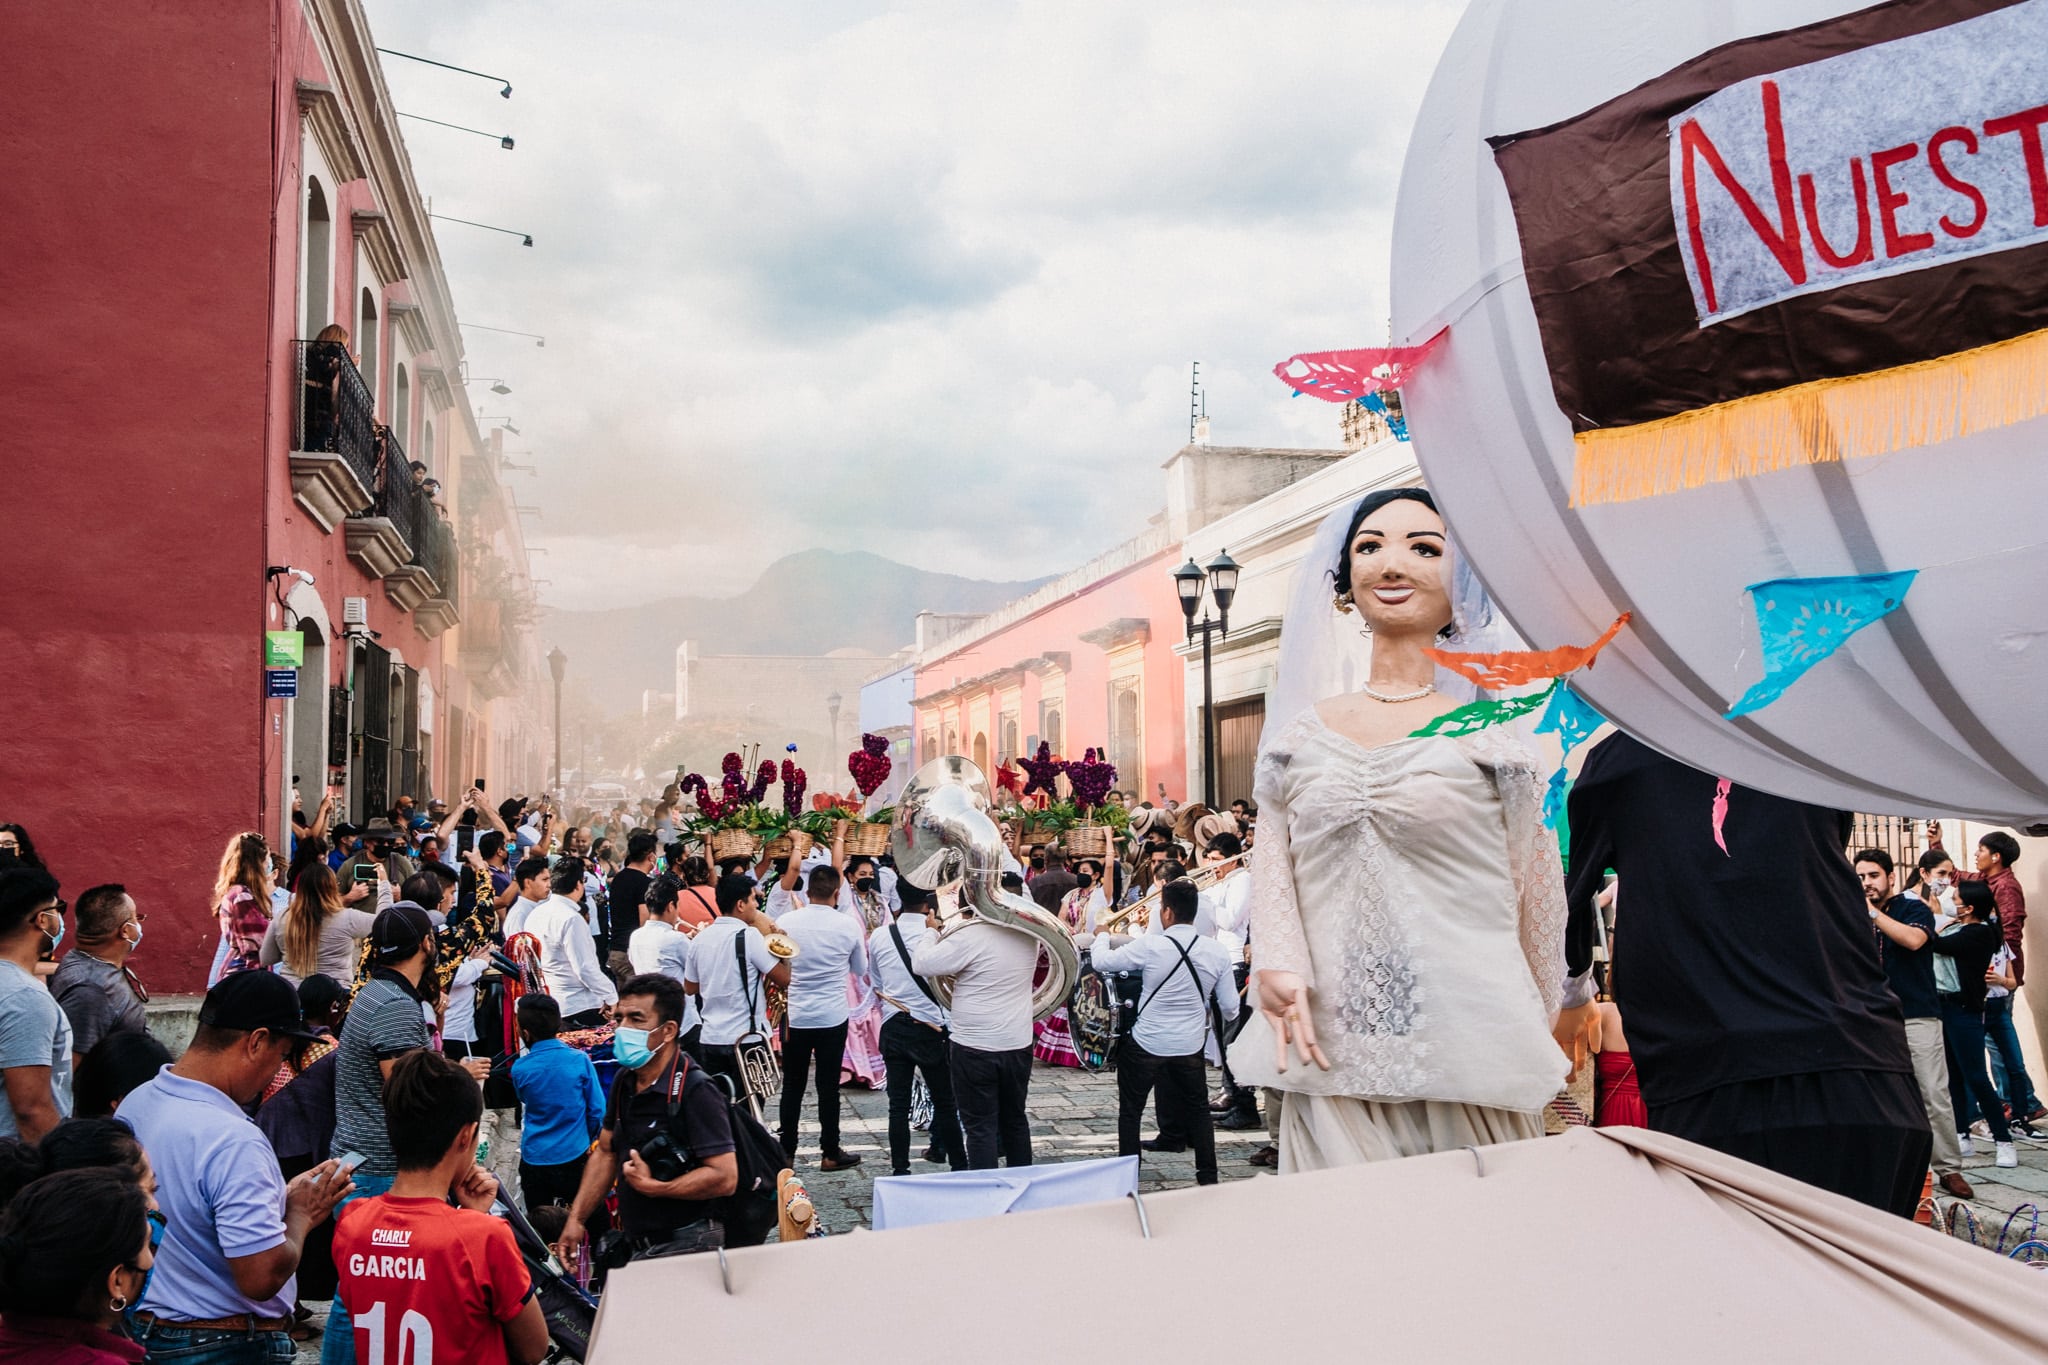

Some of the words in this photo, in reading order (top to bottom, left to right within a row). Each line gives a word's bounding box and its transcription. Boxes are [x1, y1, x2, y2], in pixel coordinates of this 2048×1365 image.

[671, 1071, 684, 1096] Canon
[371, 1228, 413, 1244] CHARLY
[349, 1253, 426, 1281] GARCIA
